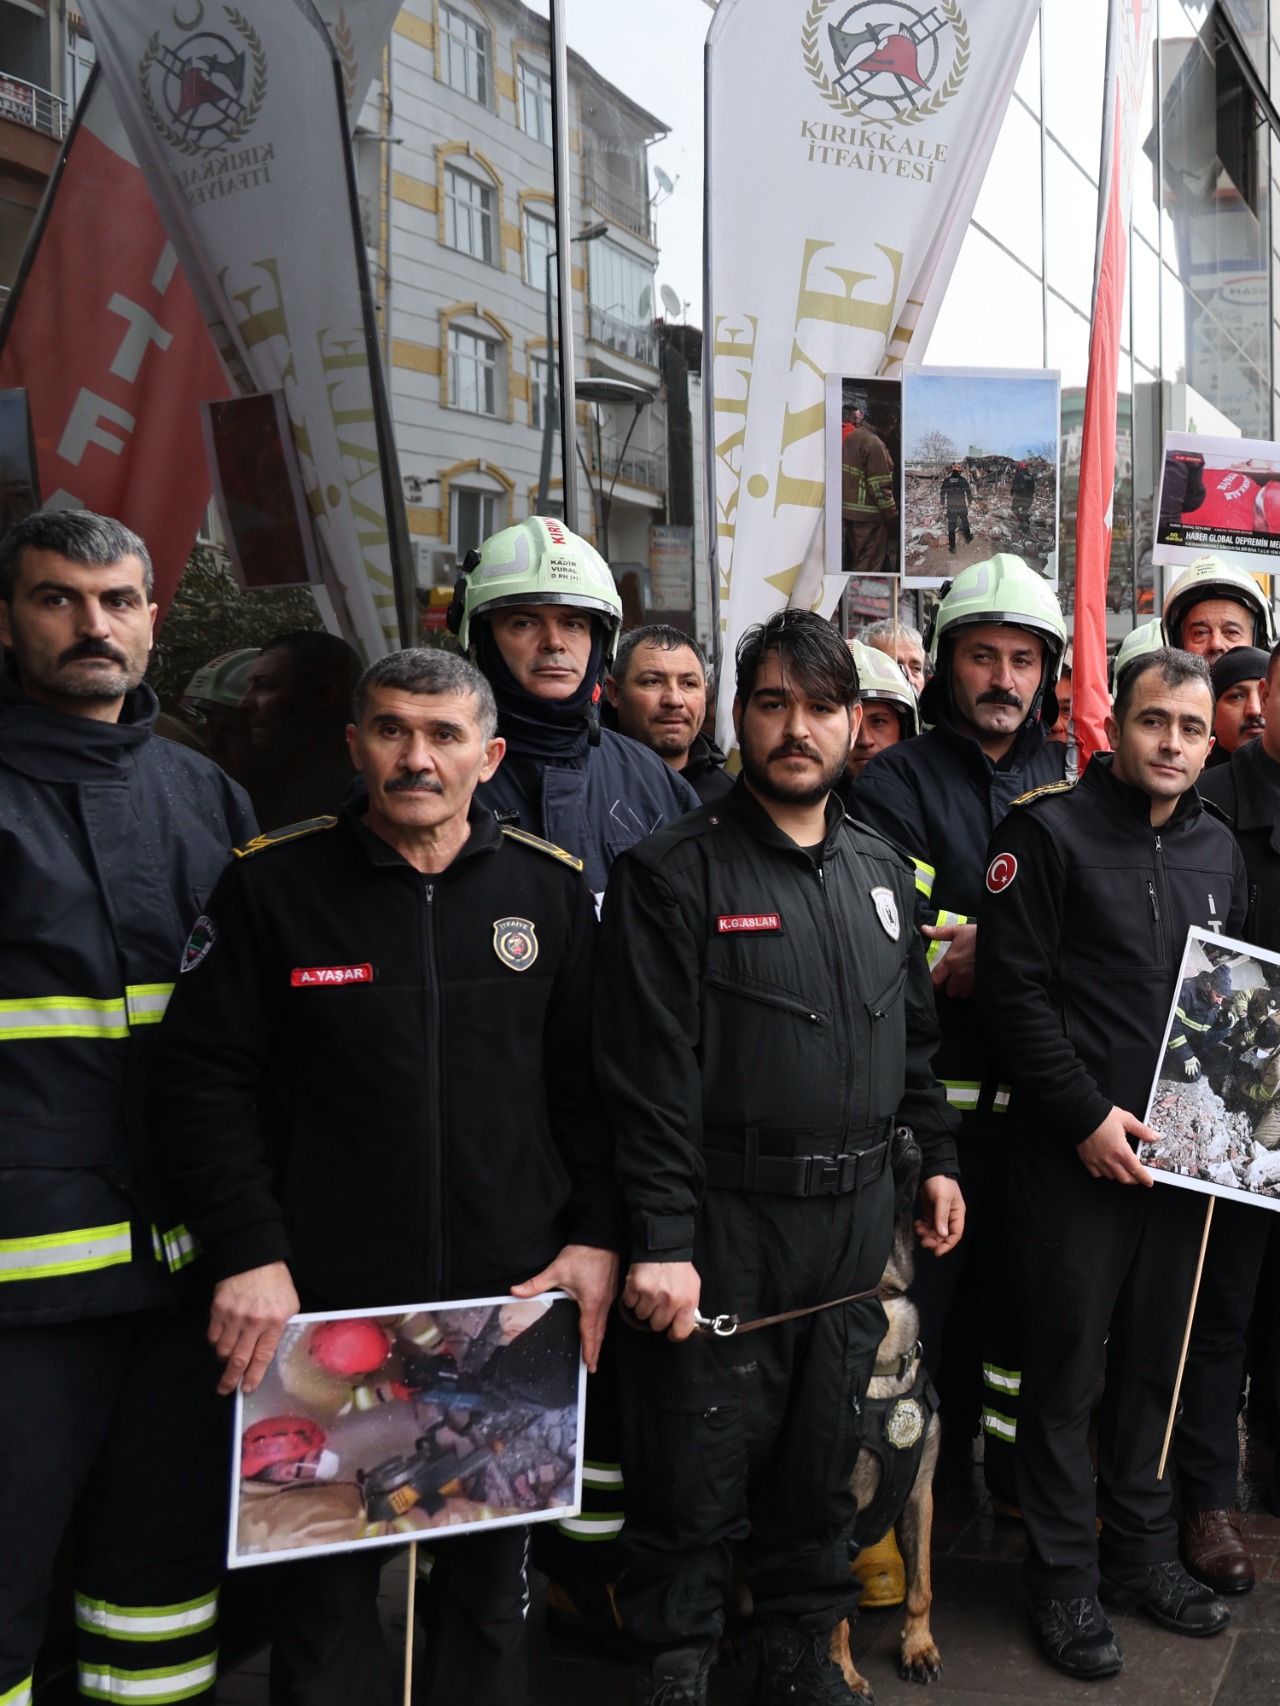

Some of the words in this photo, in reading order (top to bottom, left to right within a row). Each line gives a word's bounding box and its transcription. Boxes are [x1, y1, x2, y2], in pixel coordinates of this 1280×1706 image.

[800, 119, 949, 162] KIRIKKALE
[807, 140, 936, 183] İTFAİYESİ
[1185, 531, 1208, 541] HABER
[1209, 534, 1234, 544] GLOBAL
[1235, 536, 1269, 548] DEPREMİN
[551, 566, 578, 574] VURAL
[498, 919, 529, 931] İTFAİYE
[315, 968, 364, 982] YAŞAR
